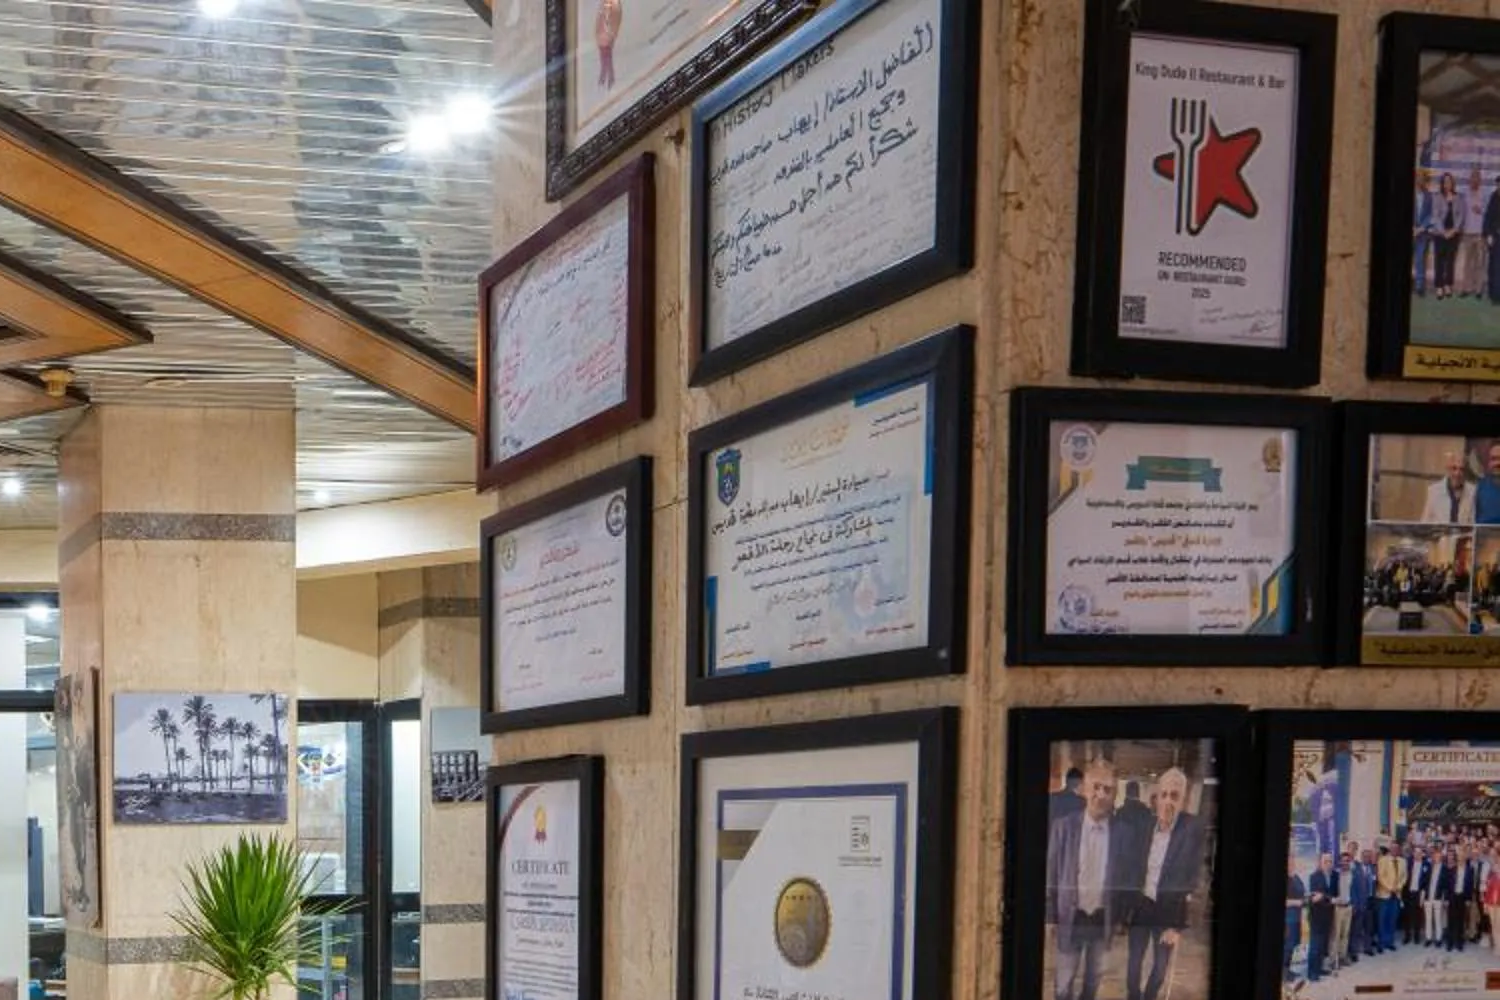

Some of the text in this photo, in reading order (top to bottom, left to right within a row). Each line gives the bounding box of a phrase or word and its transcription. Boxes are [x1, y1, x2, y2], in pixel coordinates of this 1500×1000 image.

[1134, 62, 1159, 81] King
[1198, 68, 1256, 87] Restaurant
[1267, 75, 1286, 89] Bar
[1157, 250, 1247, 273] RECOMMENDED
